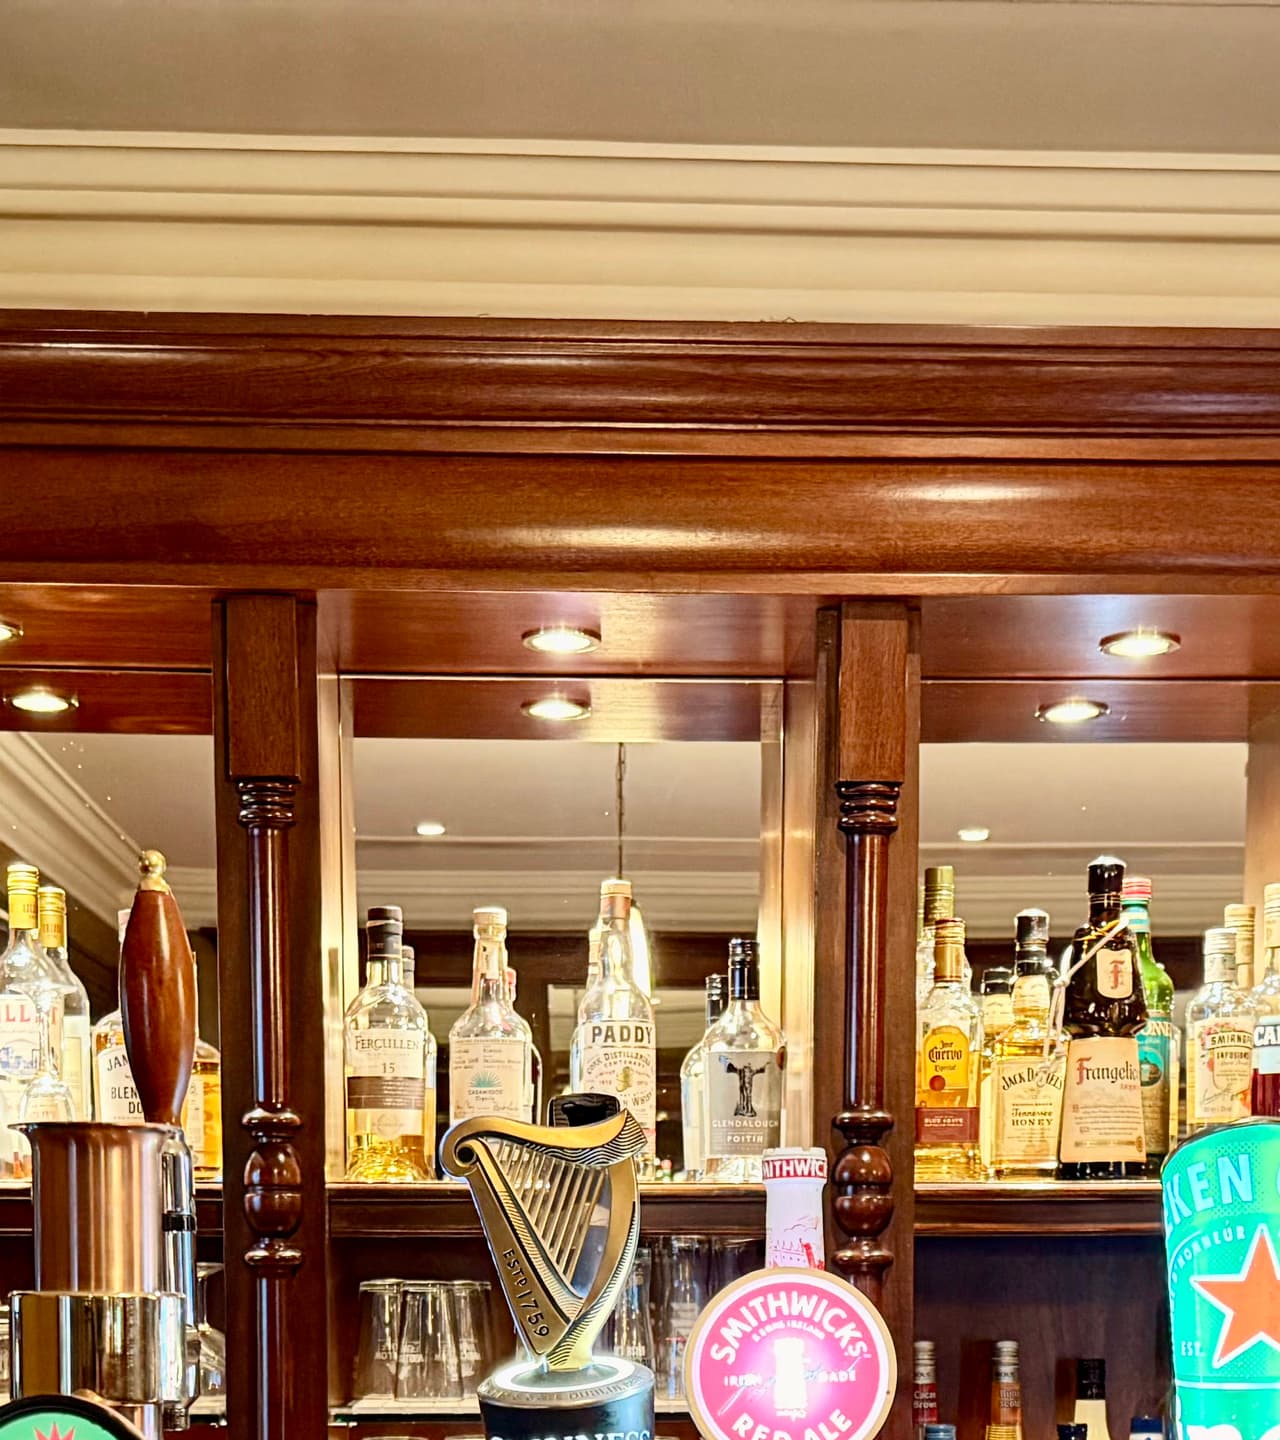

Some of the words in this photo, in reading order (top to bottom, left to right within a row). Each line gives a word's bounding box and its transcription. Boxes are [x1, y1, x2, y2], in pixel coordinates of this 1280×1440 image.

[591, 1025, 652, 1044] PADDY
[354, 1035, 419, 1051] FERCULLEN
[928, 1046, 963, 1063] Cuervo
[381, 1062, 395, 1074] 15
[1011, 1118, 1053, 1127] HONEY
[516, 1289, 551, 1338] 1759
